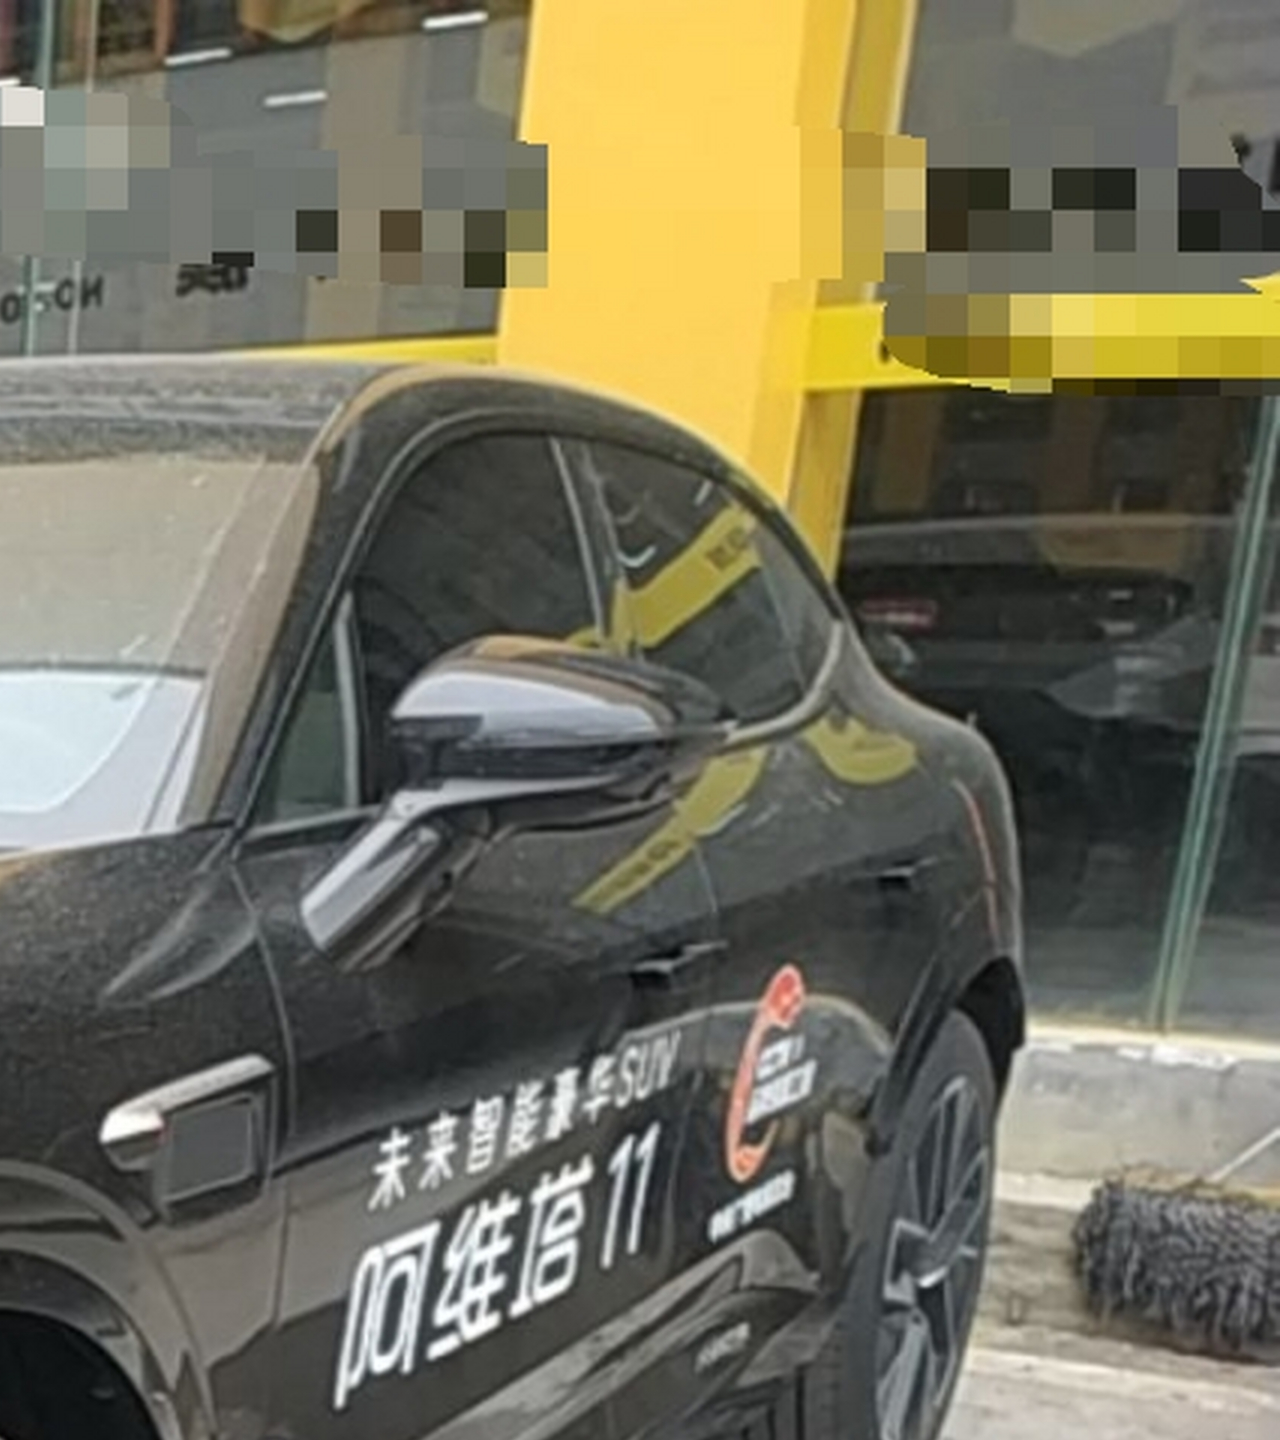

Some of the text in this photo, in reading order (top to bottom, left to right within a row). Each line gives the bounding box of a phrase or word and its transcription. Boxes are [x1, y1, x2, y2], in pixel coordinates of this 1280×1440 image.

[368, 1031, 681, 1211] 未来智能豪华SUV
